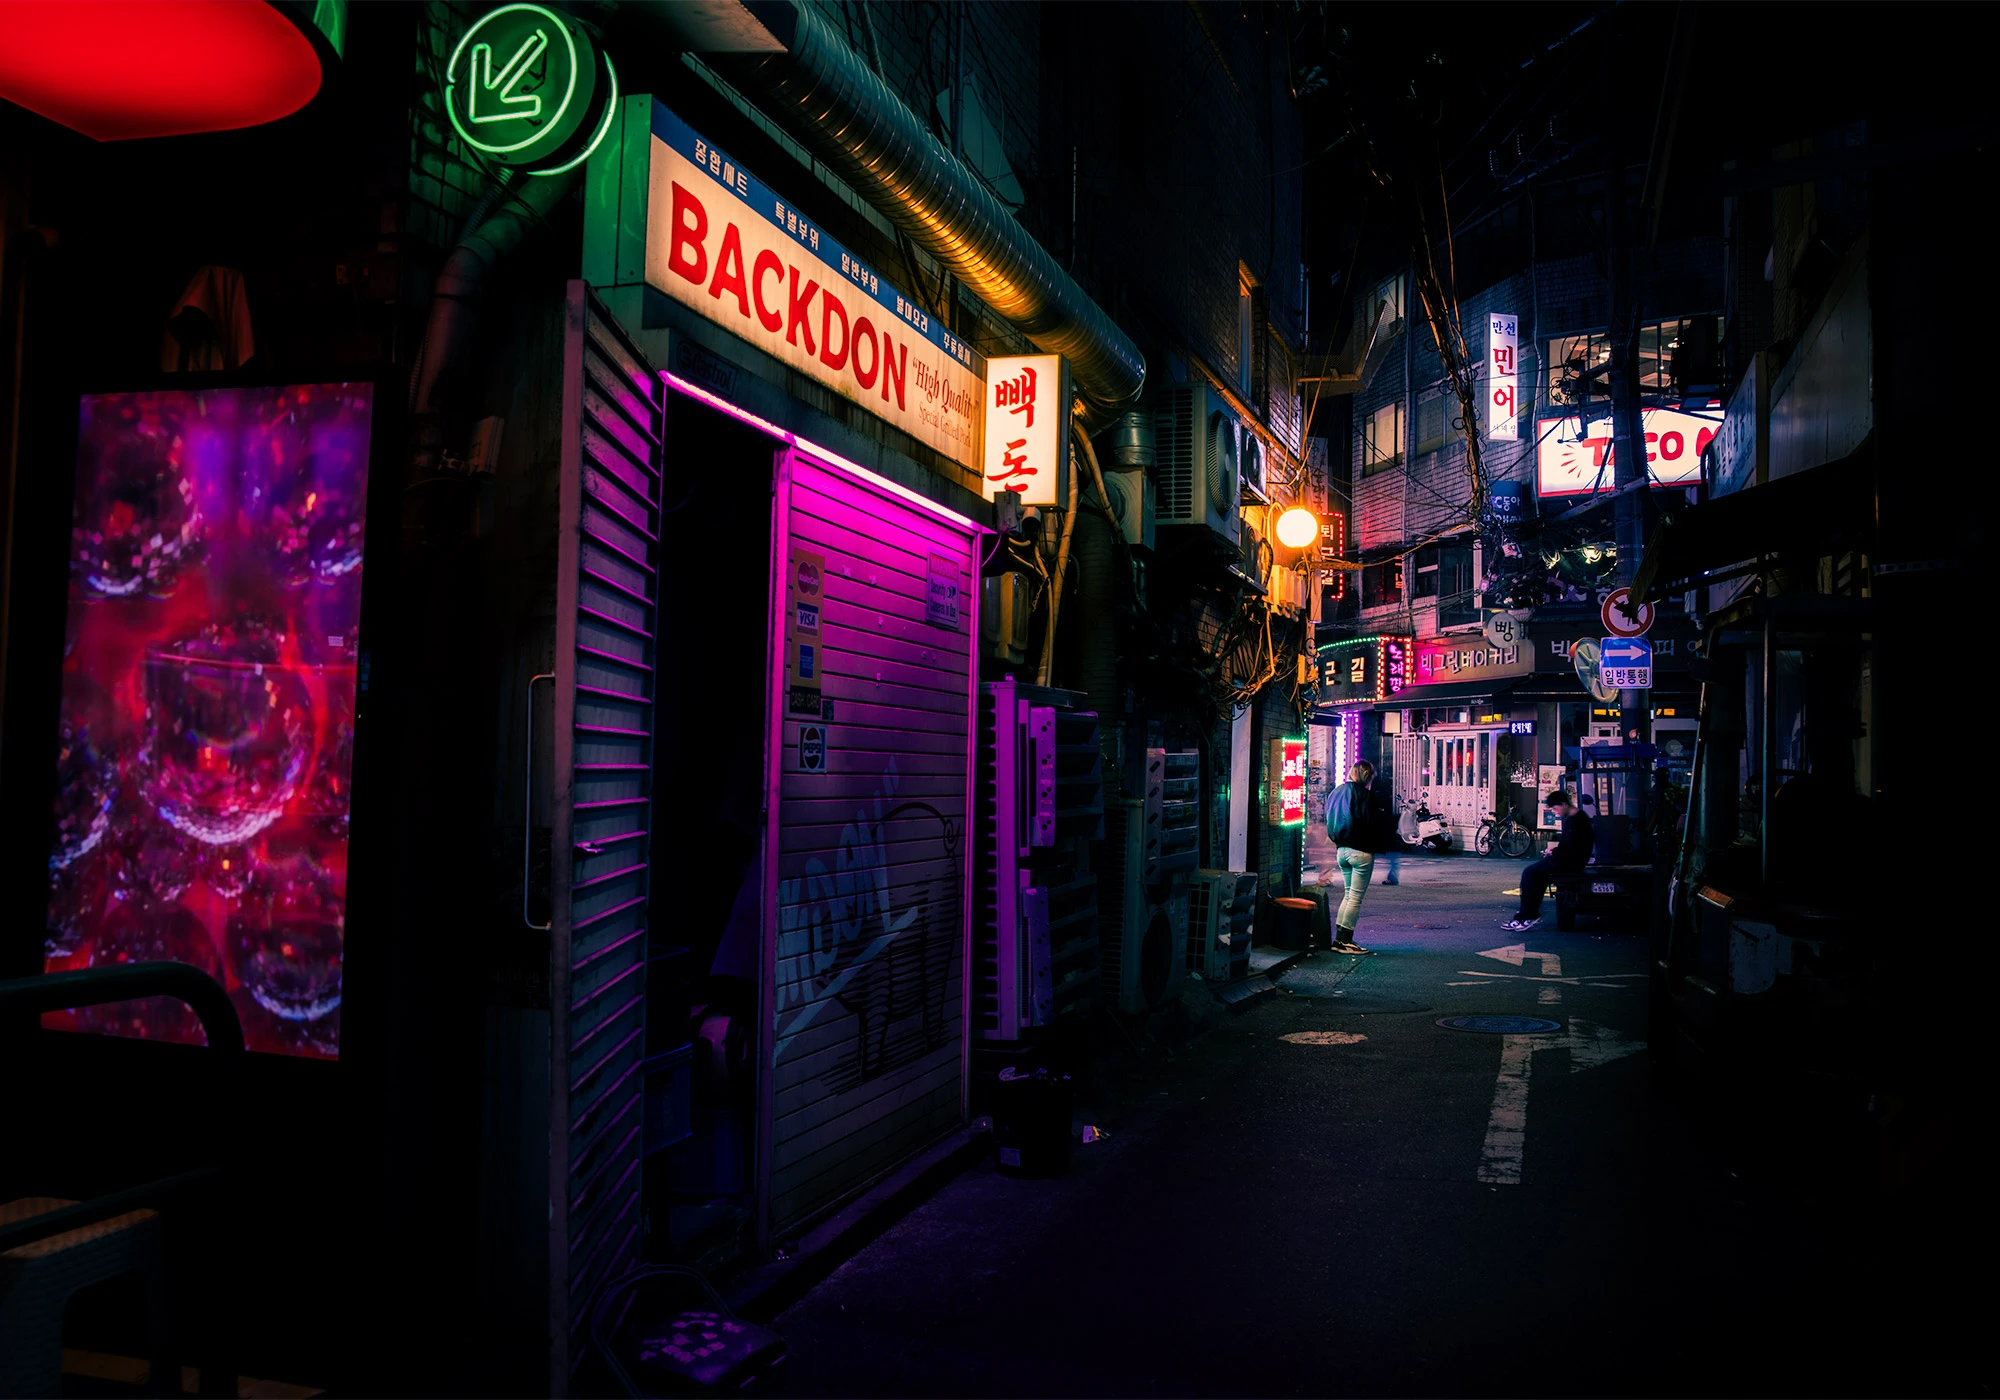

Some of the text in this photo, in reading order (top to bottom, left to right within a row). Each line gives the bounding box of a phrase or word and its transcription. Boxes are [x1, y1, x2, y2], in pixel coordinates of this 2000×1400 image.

[775, 201, 819, 251] 특별부위
[841, 252, 878, 296] 일반부위
[896, 295, 928, 333] 별미요리
[668, 180, 908, 412] BACKDON
[1492, 320, 1516, 336] 만선
[1493, 345, 1515, 417] 민어
[986, 366, 1038, 492] 빽돈
[800, 611, 816, 627] VISA
[1494, 621, 1514, 642] 빵
[1605, 669, 1648, 685] 일방통행
[803, 742, 822, 754] PEPSI
